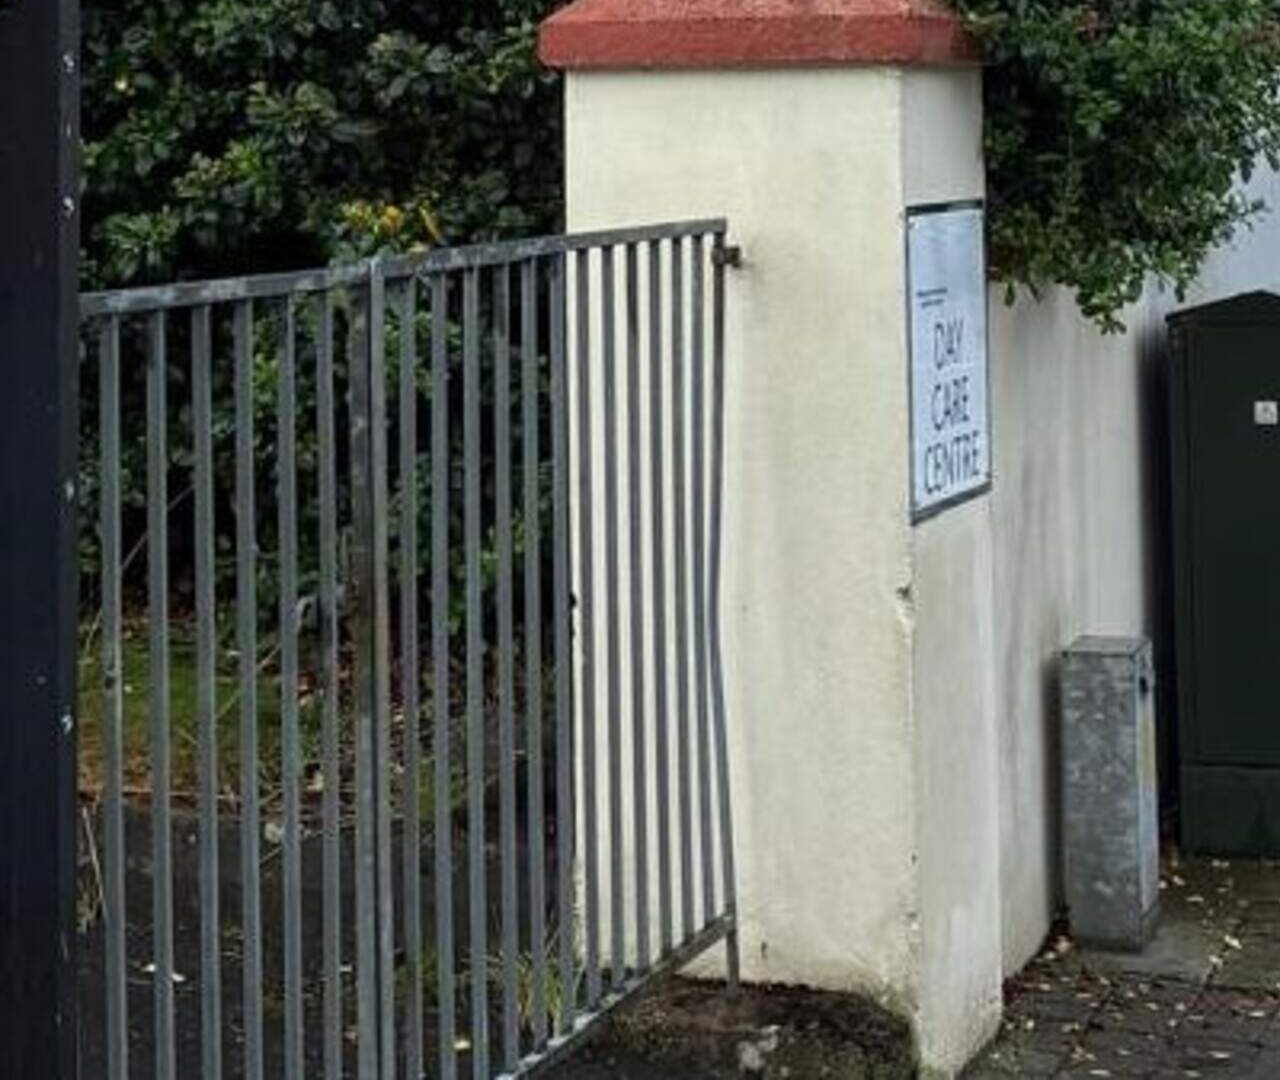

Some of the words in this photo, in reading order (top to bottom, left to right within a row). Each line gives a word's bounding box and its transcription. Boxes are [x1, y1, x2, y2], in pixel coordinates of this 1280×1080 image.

[933, 317, 965, 370] DAY
[931, 375, 970, 431] CARE
[924, 430, 980, 494] CENTRE
